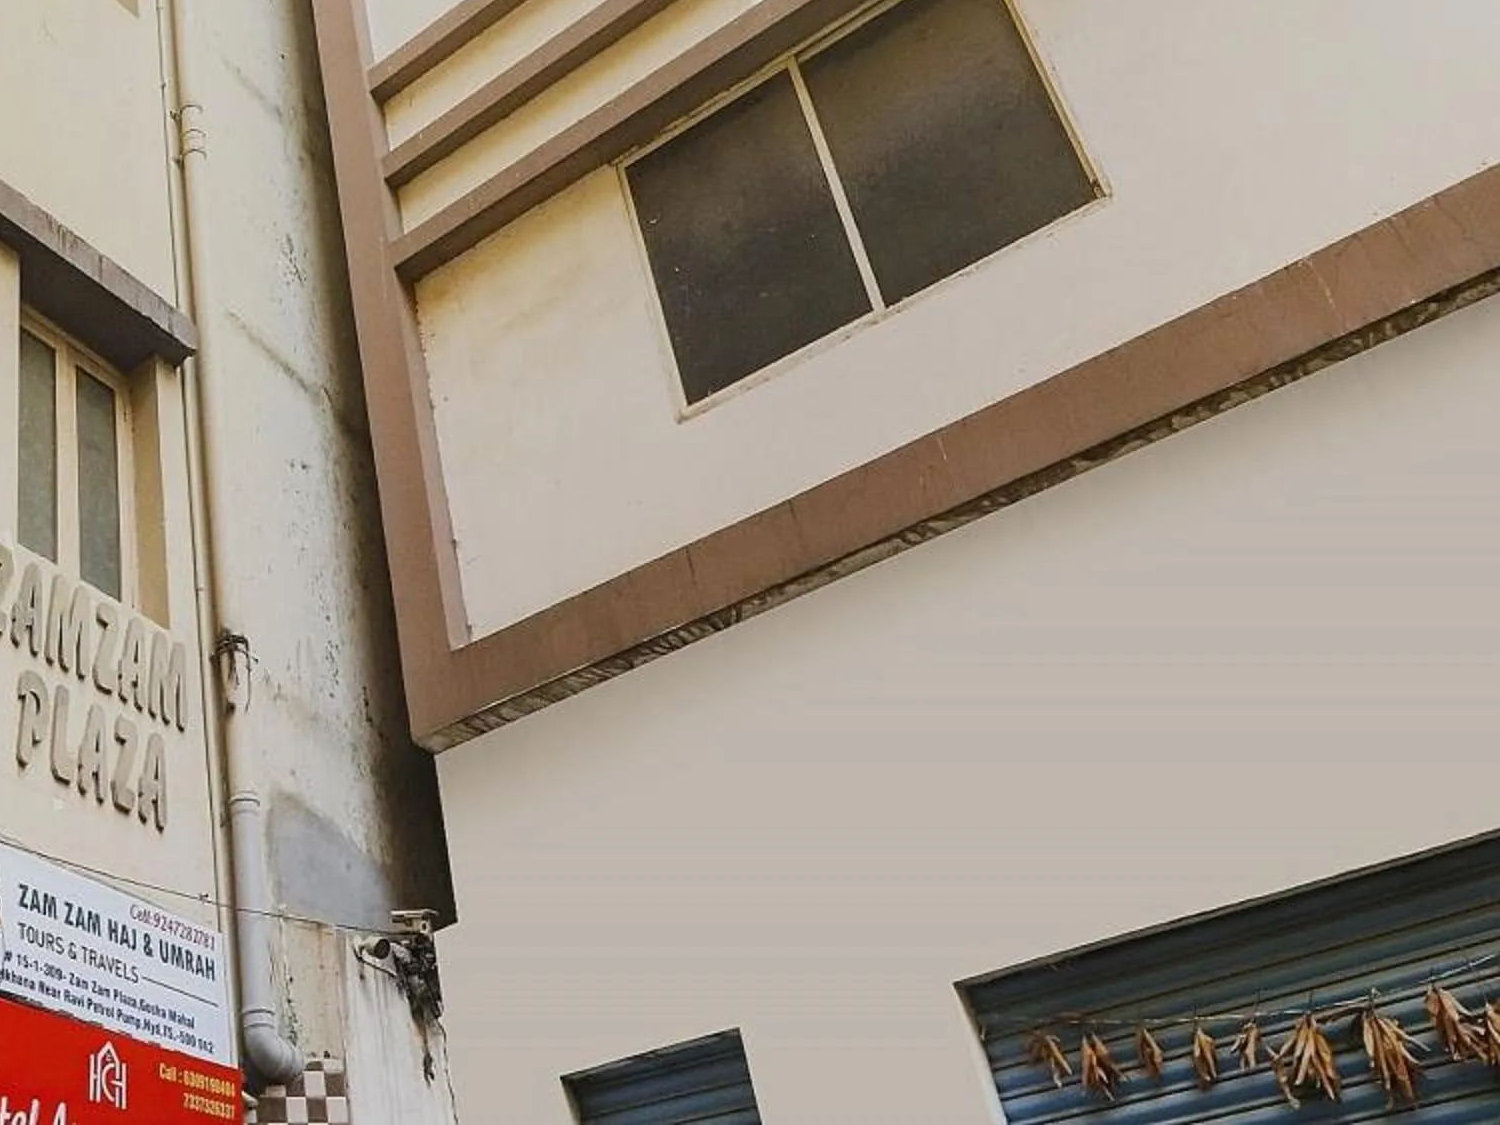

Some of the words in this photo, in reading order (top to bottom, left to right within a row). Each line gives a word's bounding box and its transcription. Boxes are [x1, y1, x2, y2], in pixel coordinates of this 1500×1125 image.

[15, 669, 168, 834] PLAZA
[18, 883, 57, 920] ZAM
[63, 901, 101, 937] ZAM
[107, 918, 137, 951] HAJ
[143, 932, 154, 958] &
[159, 938, 216, 981] UMRAH
[18, 922, 65, 955] TOURS
[67, 941, 77, 960] &
[81, 945, 140, 984] TRAVELS
[39, 980, 62, 1000] Near
[64, 988, 85, 1008] Ravi
[69, 971, 89, 990] Zam
[91, 980, 111, 998] Zam
